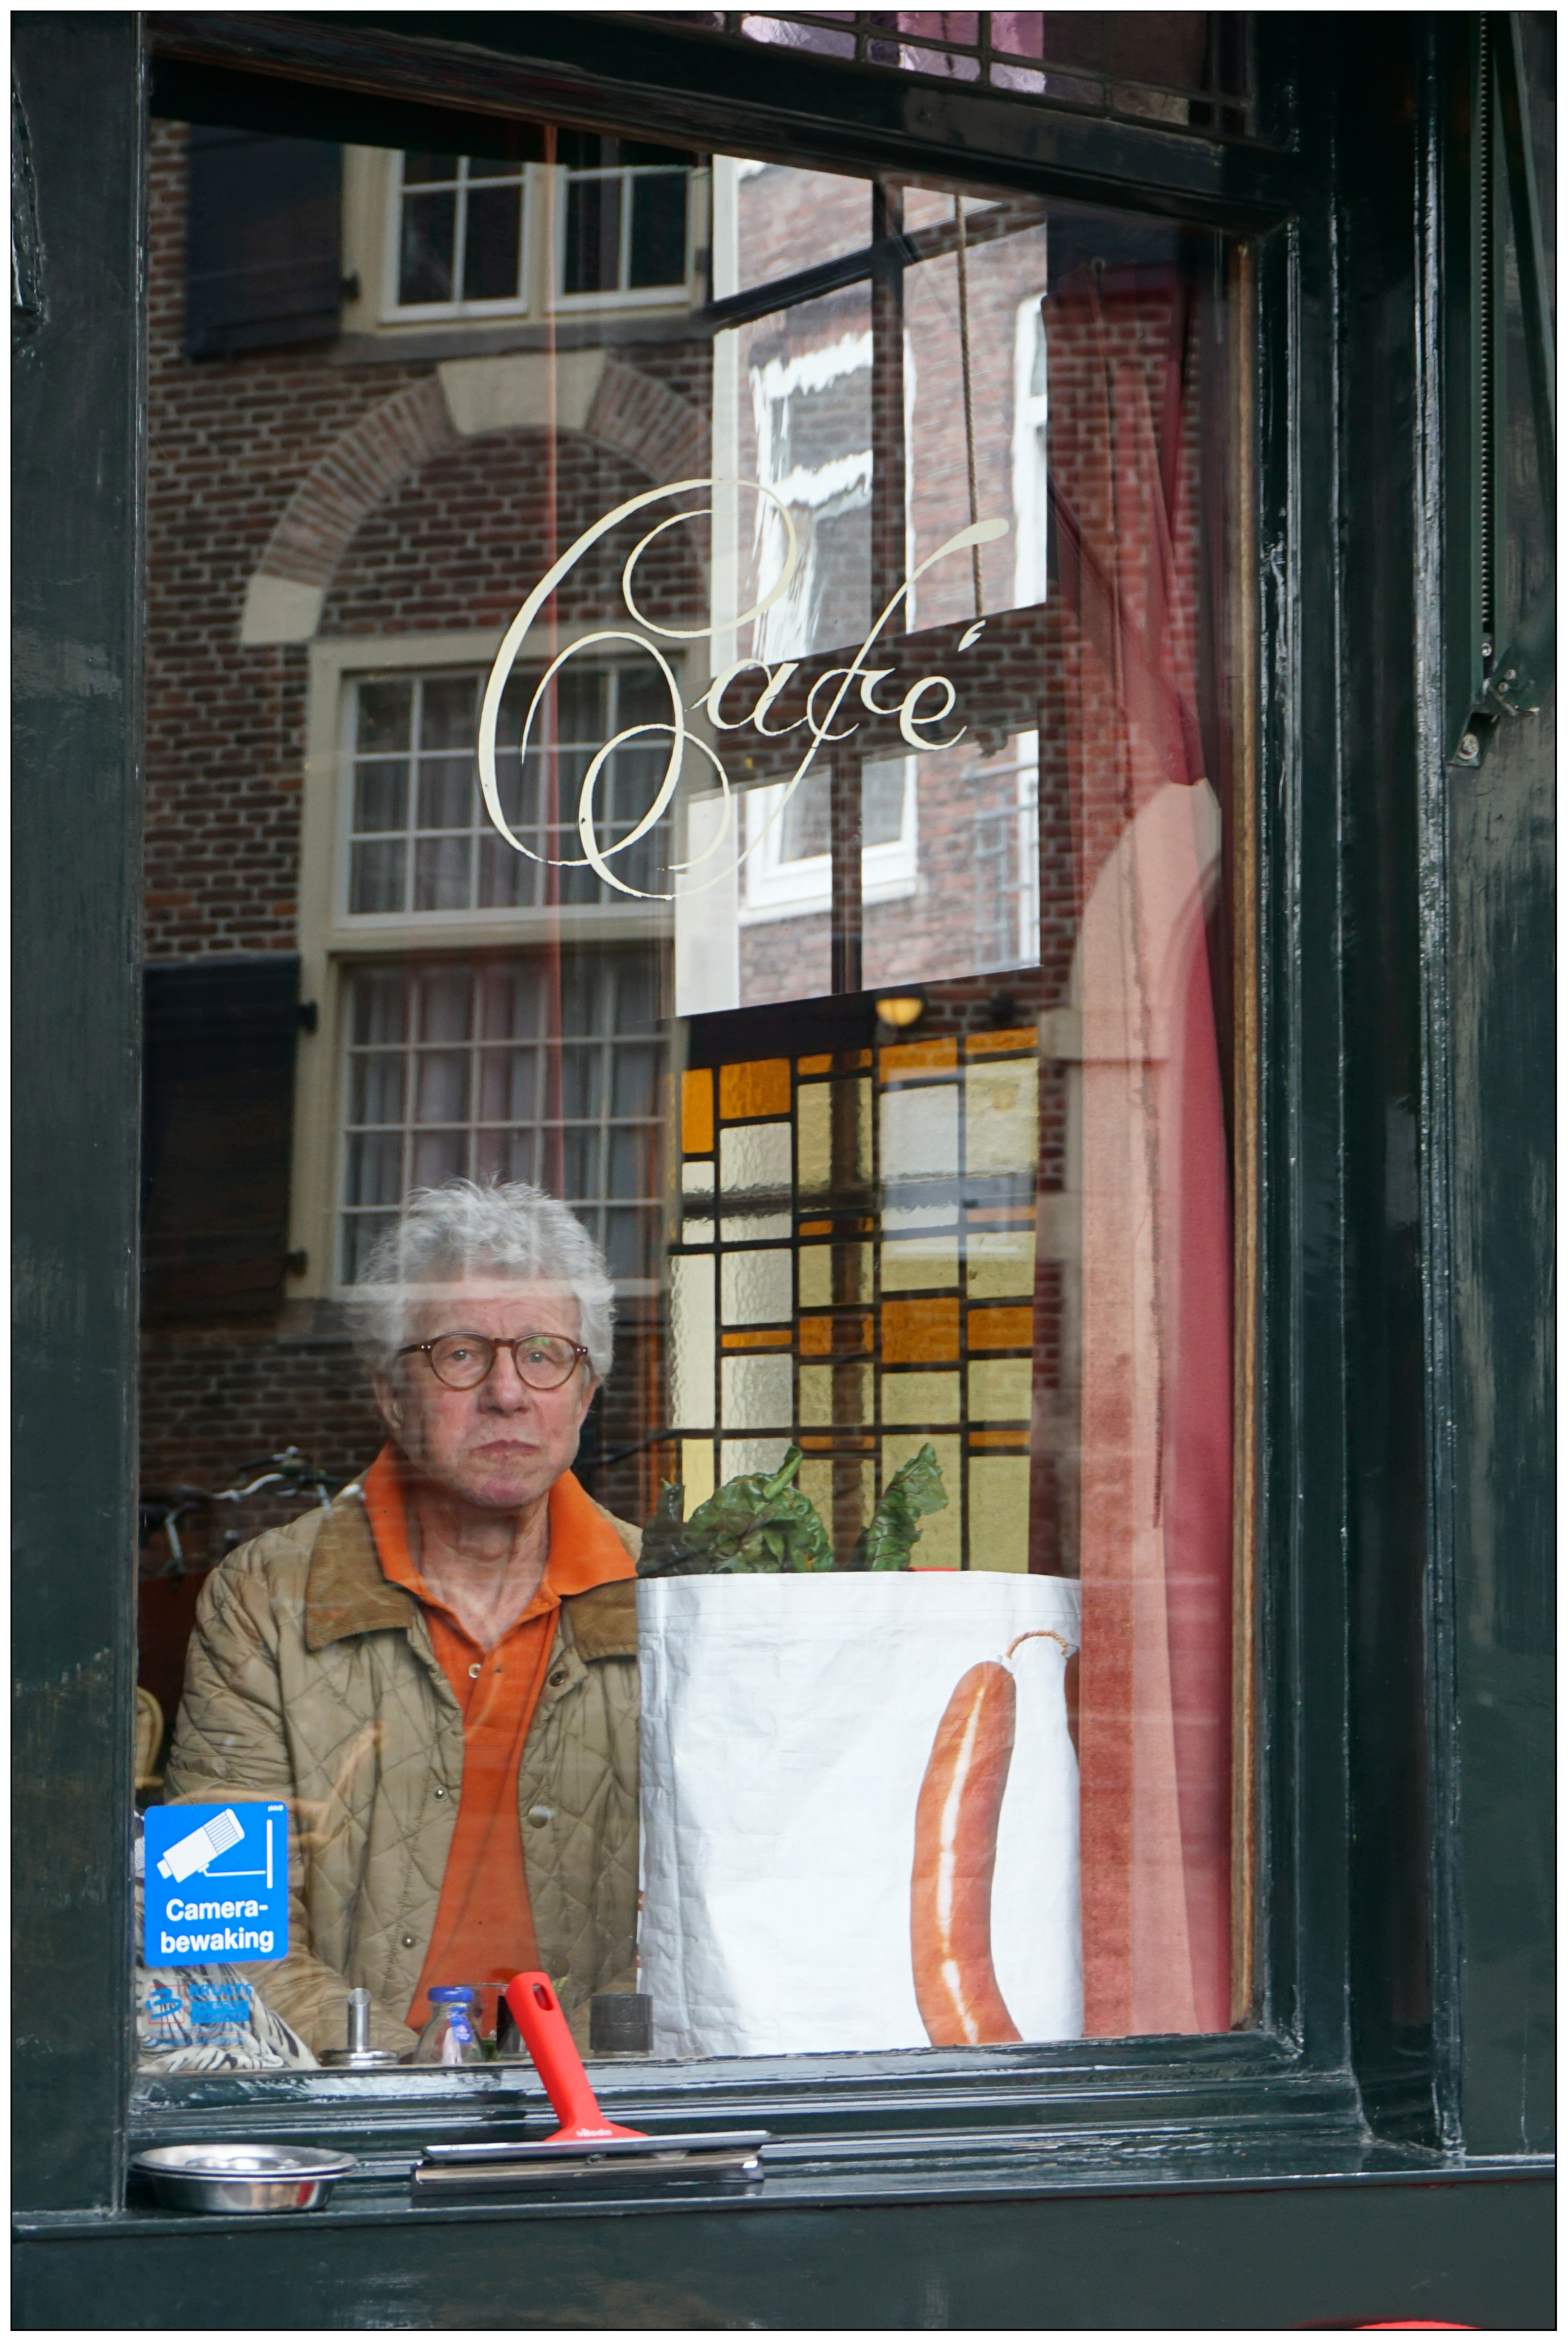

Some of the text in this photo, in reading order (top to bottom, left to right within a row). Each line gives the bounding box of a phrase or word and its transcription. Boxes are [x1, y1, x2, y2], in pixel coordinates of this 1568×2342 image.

[479, 478, 1009, 900] Café
[166, 1898, 269, 1922] Camera-
[161, 1926, 274, 1953] bewaking
